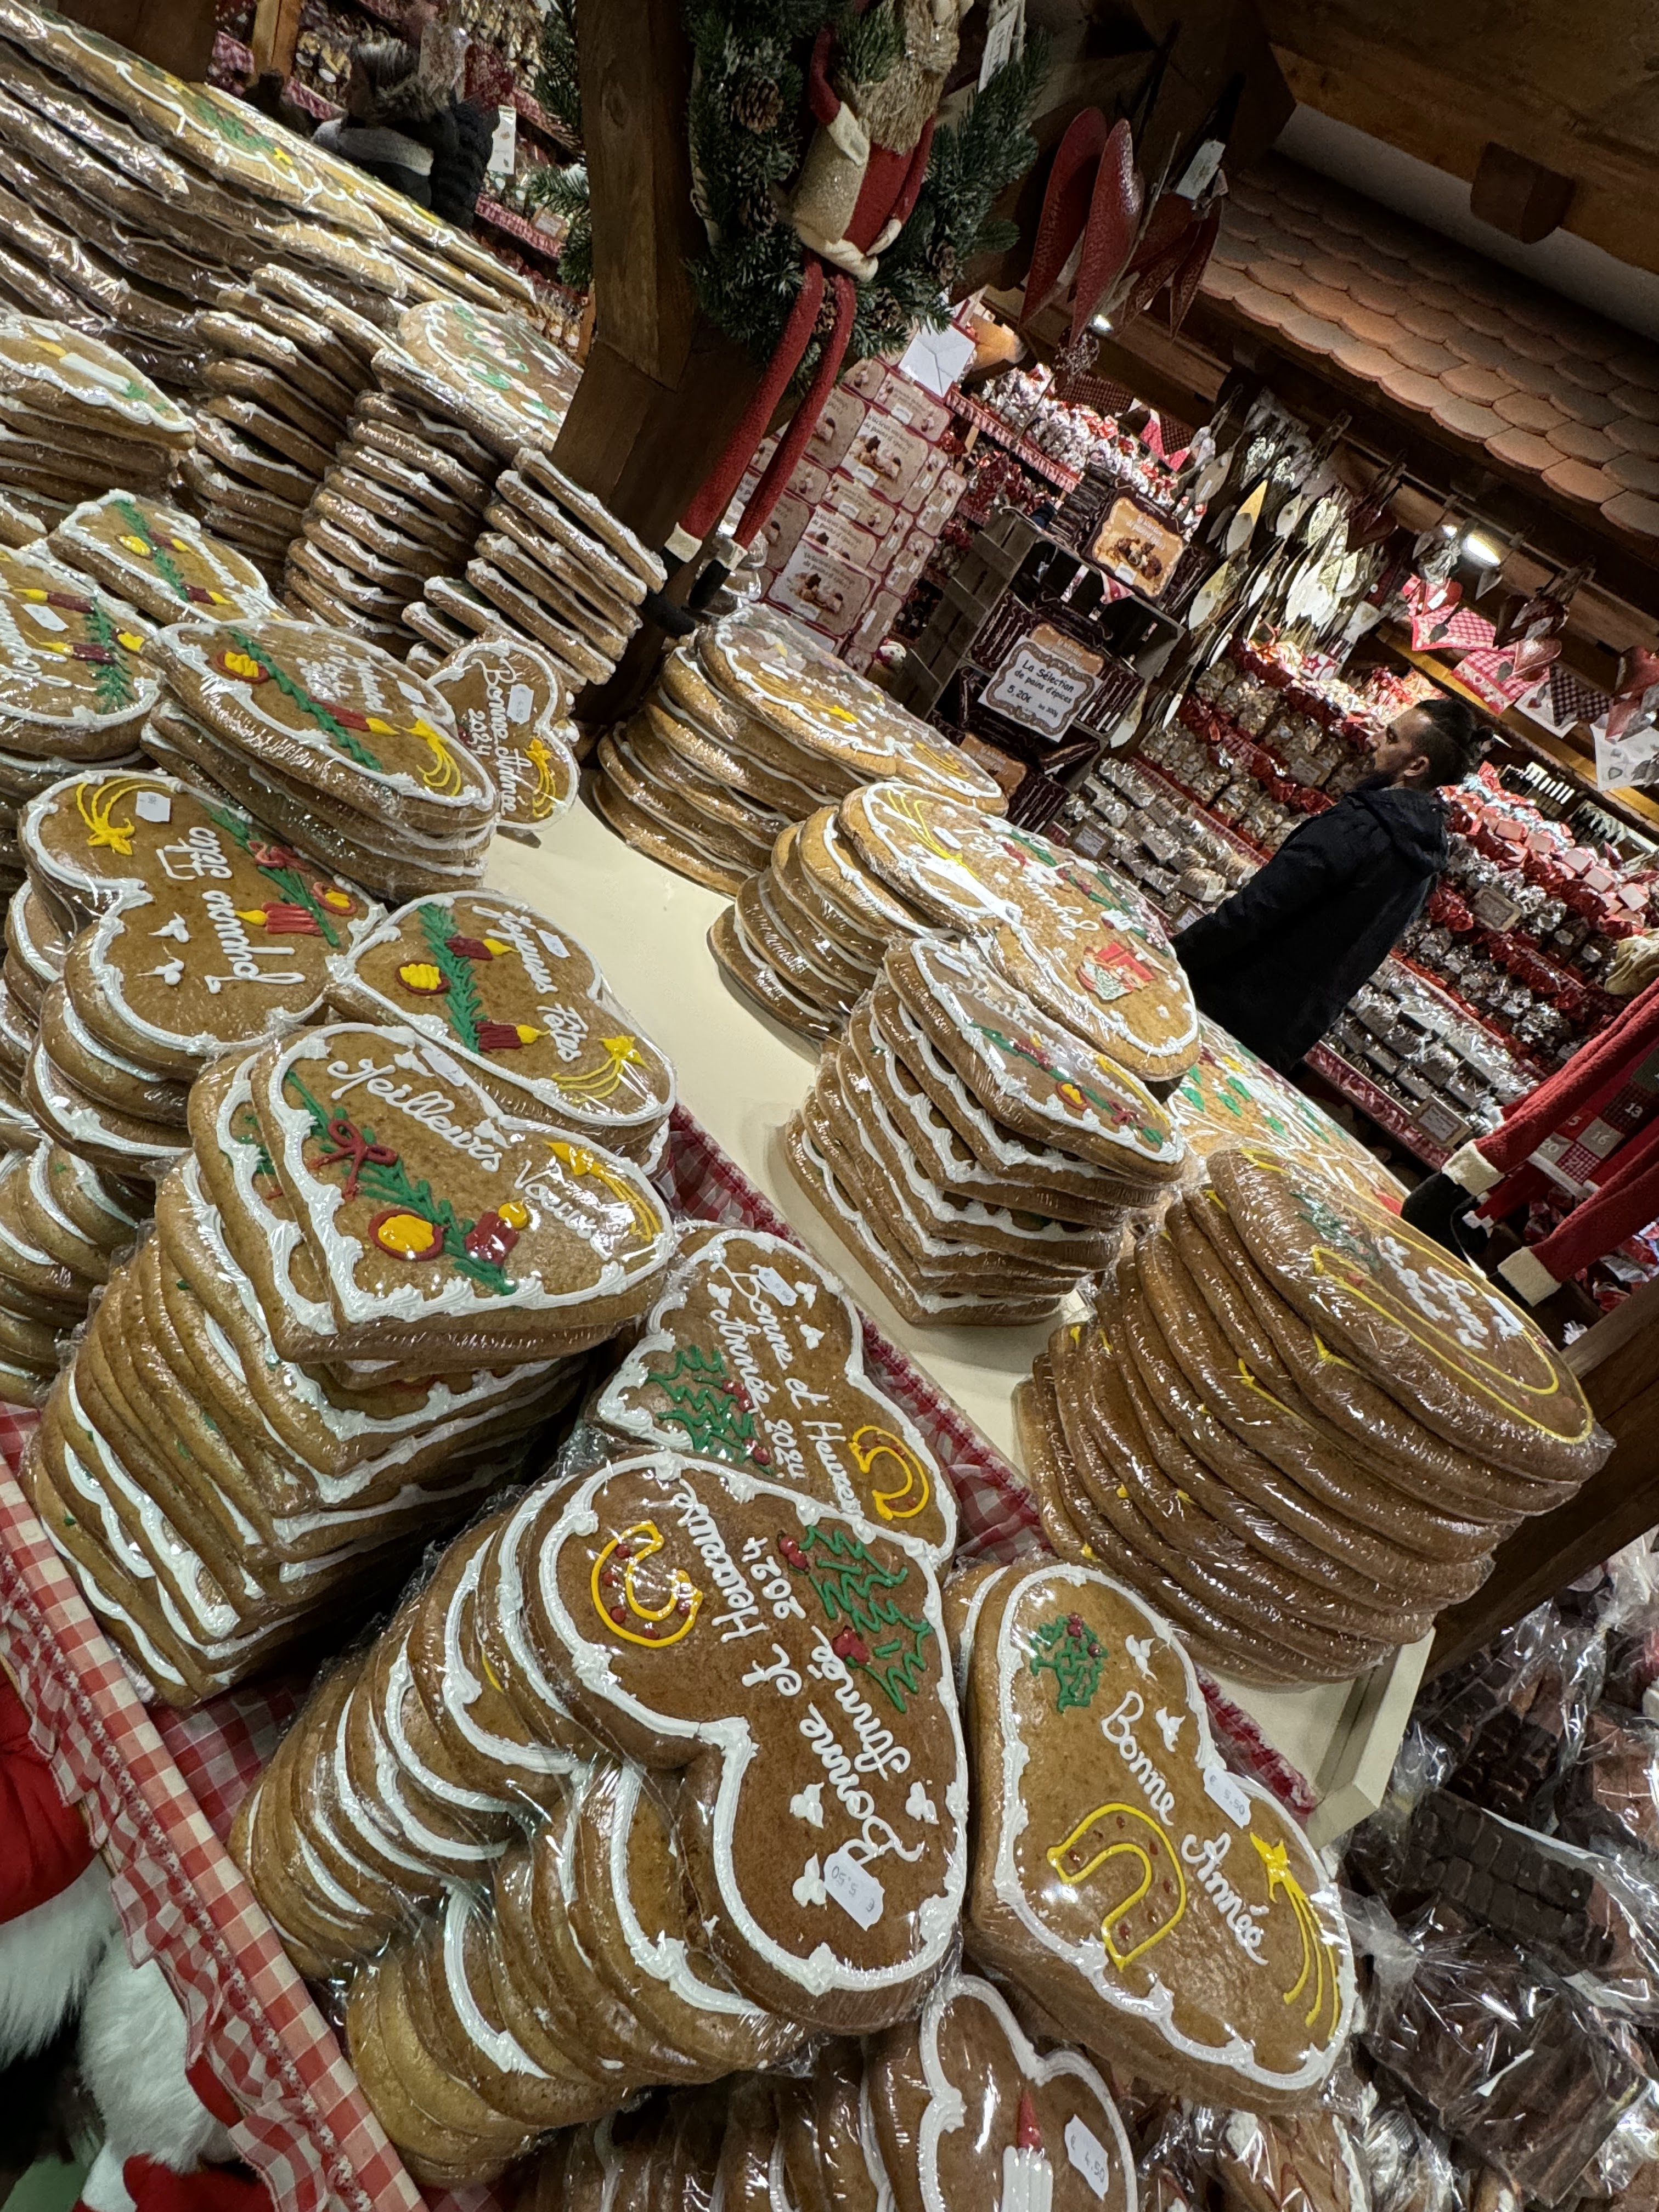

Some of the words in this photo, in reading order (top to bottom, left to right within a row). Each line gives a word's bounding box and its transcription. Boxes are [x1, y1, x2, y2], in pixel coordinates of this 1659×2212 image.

[1014, 670, 1024, 679] de
[1025, 676, 1045, 690] pains
[1046, 686, 1073, 704] d'épices
[1022, 659, 1035, 673] La
[1036, 668, 1074, 693] Sélection
[468, 708, 492, 757] 2024
[471, 658, 517, 747] Bonne
[495, 746, 532, 816] Année
[472, 905, 559, 994] Joyeuses
[328, 1058, 503, 1172] Meilleurs
[1592, 1130, 1607, 1146] 16
[1624, 1103, 1644, 1118] 13
[710, 1262, 794, 1370] Bonne
[785, 1378, 830, 1410] et
[710, 1309, 770, 1418] Année
[673, 1478, 768, 1643] Heureuse
[742, 1537, 806, 1620] 2024
[742, 1644, 803, 1697] et
[811, 1626, 911, 1781] Année
[800, 1703, 924, 1865] Bonne
[1223, 1788, 1246, 1815] 5.50
[1102, 1691, 1173, 1826] Bonne
[1182, 1832, 1270, 1966] Année
[830, 1863, 860, 1898] 5.50
